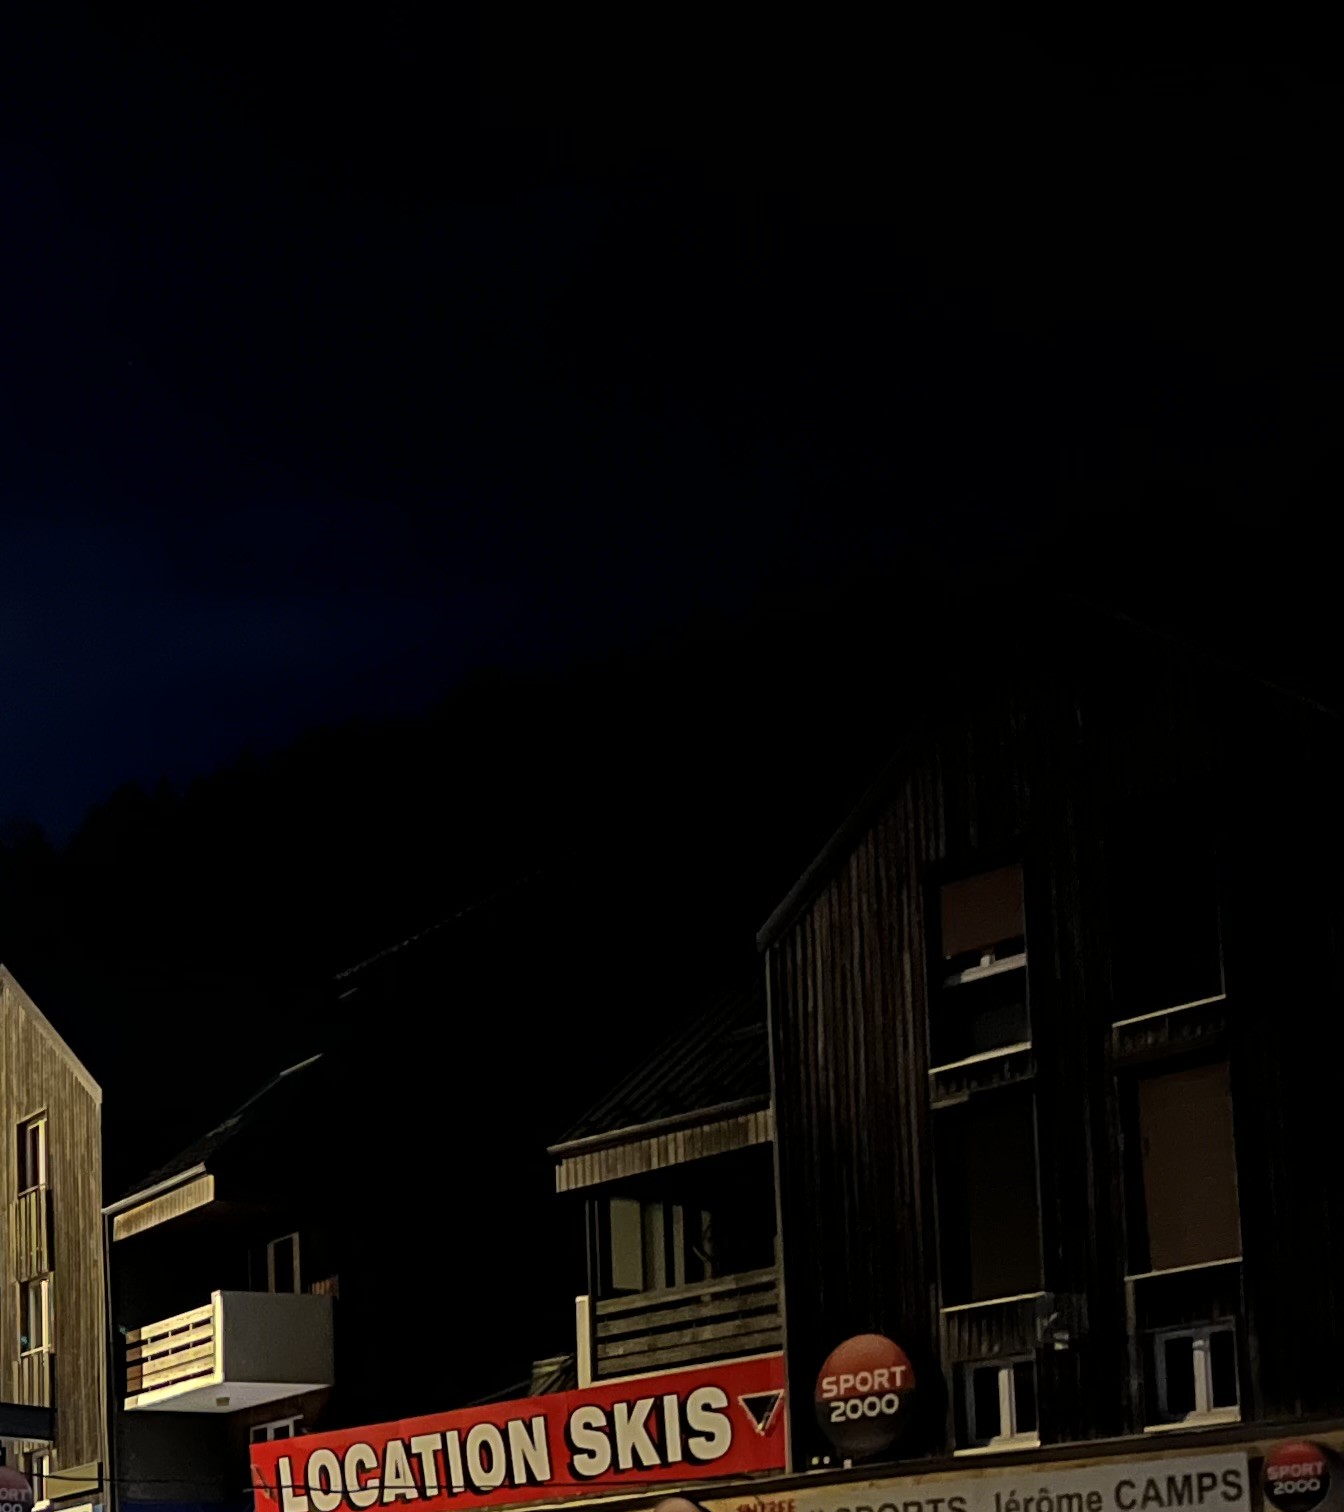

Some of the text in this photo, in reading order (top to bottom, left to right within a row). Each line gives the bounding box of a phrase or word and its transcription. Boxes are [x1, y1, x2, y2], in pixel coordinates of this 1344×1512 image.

[821, 1365, 906, 1399] SPORT
[829, 1393, 900, 1423] 2000
[569, 1385, 732, 1478] SKIS
[1267, 1460, 1324, 1481] SPORT
[1272, 1477, 1322, 1495] 2000
[1113, 1468, 1244, 1511] CAMPS
